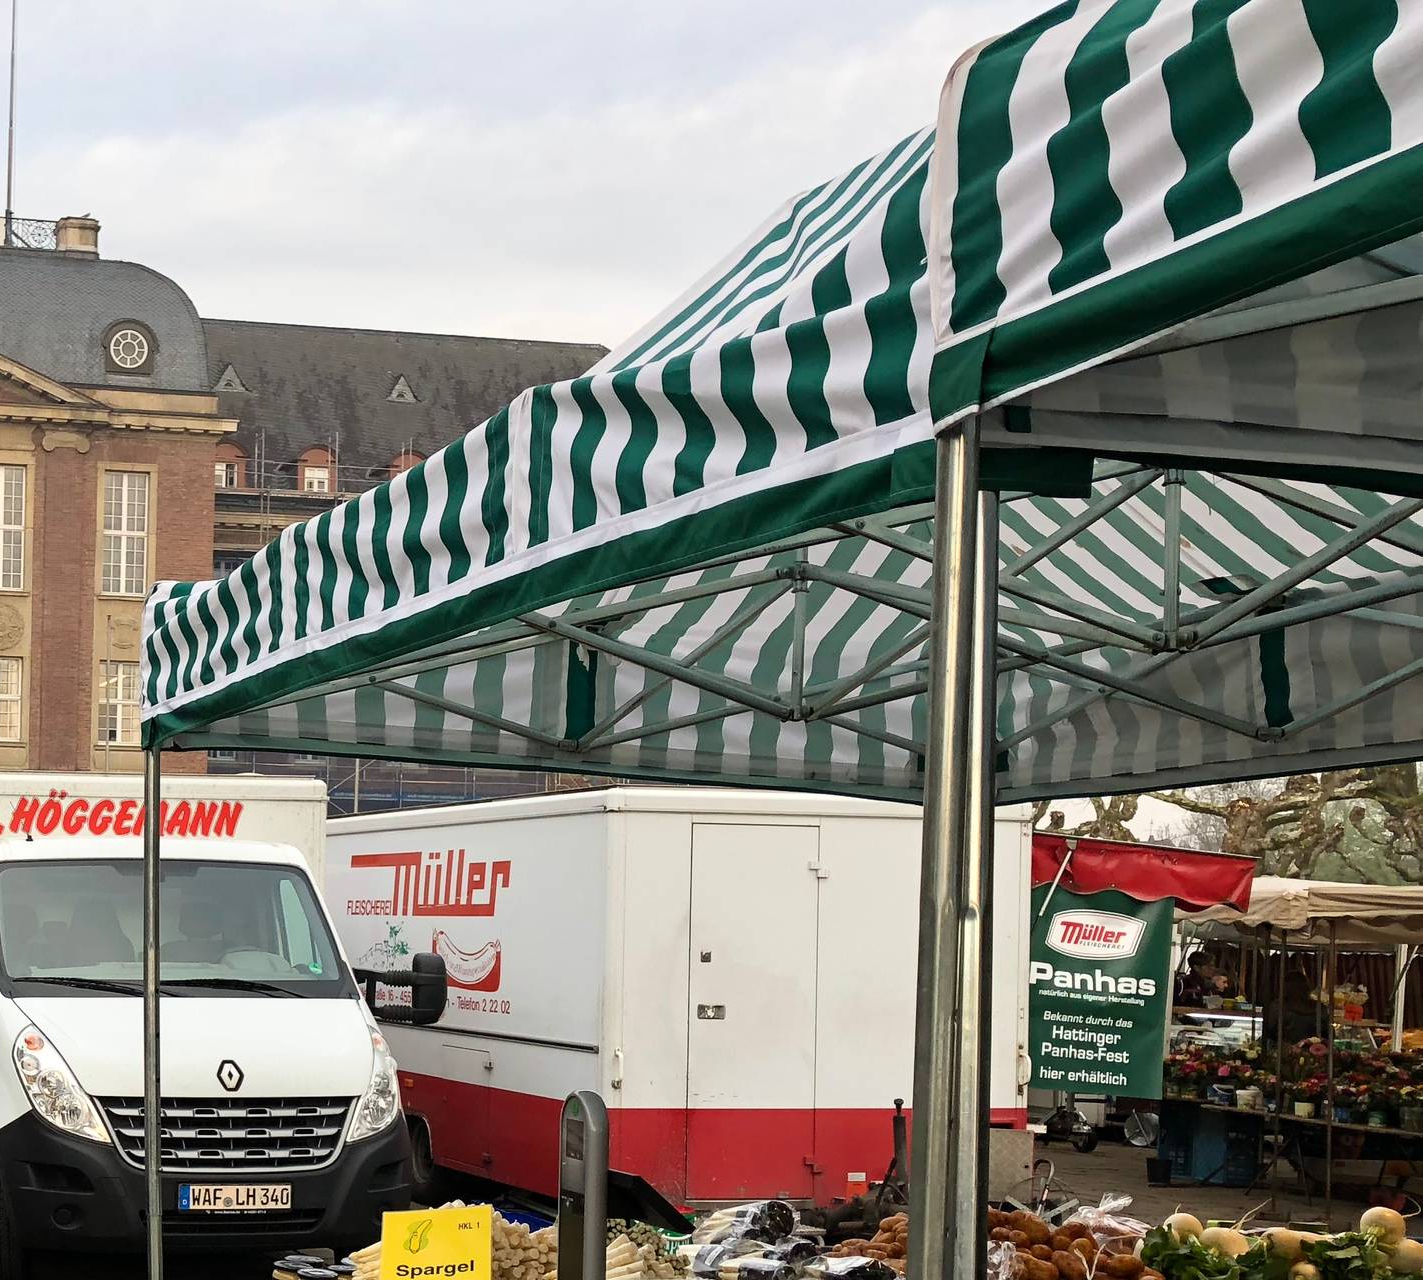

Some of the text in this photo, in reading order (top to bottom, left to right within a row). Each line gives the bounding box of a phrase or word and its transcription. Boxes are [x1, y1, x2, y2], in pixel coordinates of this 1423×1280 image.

[351, 849, 512, 917] Müller
[346, 900, 392, 916] FLEISCHEREI
[1060, 921, 1127, 945] Müller
[1028, 960, 1156, 996] Panhas
[457, 995, 481, 1012] Telefon
[482, 998, 487, 1013] 2
[489, 998, 499, 1014] 22
[500, 1000, 511, 1015] 02
[1038, 988, 1145, 1007] natürlich aus eigener Herstellung
[1043, 1010, 1134, 1029] Bekannt durch das
[1052, 1025, 1122, 1047] Hattinger
[1041, 1042, 1130, 1064] Panhas-Fest
[1039, 1066, 1128, 1086] hier erhältlich
[191, 1187, 223, 1207] WAF
[235, 1187, 256, 1206] LH
[260, 1187, 290, 1206] 340
[458, 1221, 481, 1231] HKL 1
[396, 1259, 475, 1279] Spargel
